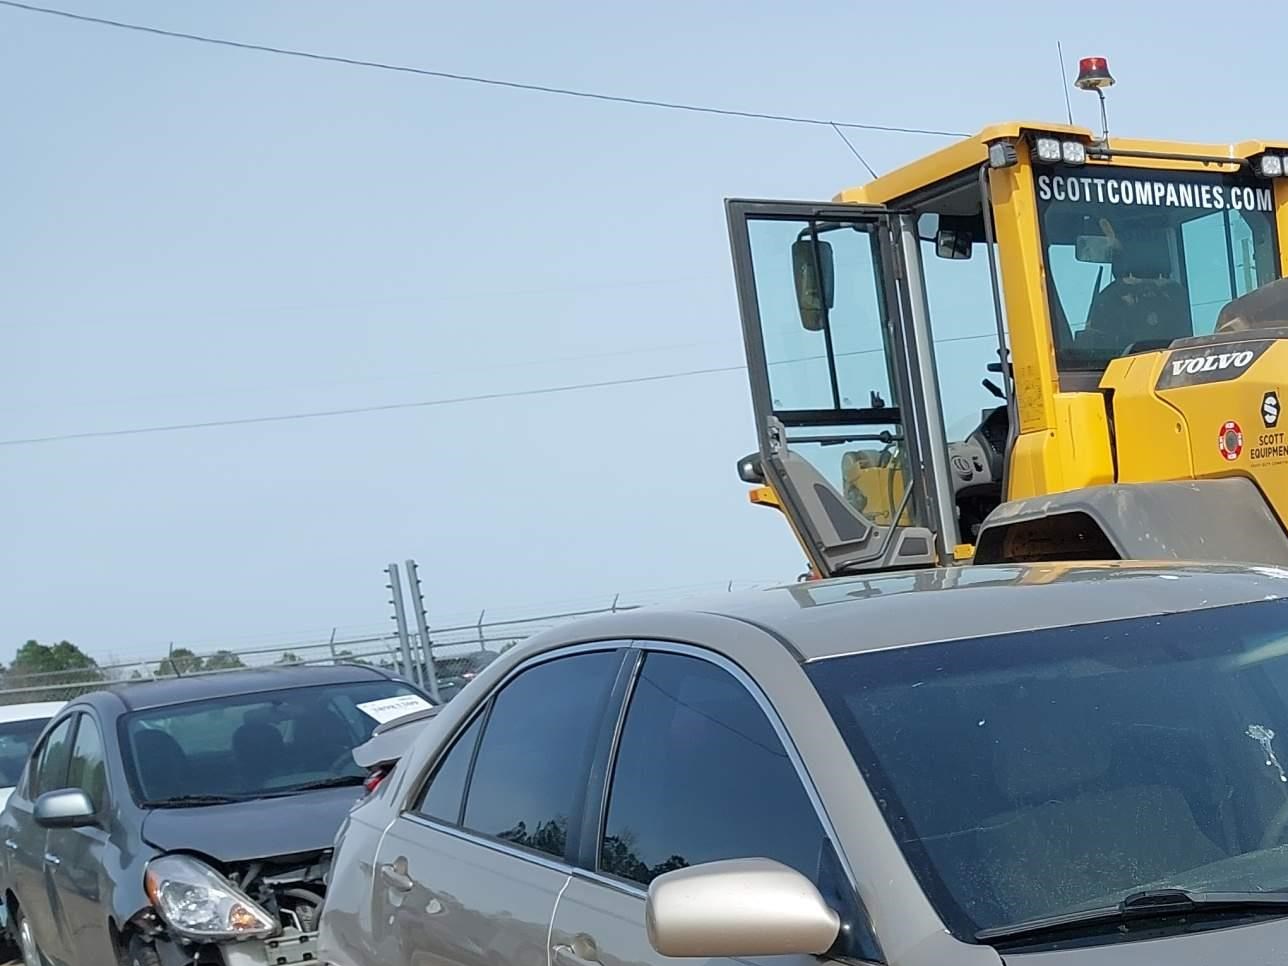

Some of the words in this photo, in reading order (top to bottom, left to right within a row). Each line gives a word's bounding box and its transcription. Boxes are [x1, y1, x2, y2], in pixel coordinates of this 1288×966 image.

[1038, 175, 1273, 212] SCOTTCOMPANIES.COM
[1172, 350, 1254, 376] VOLVO
[1258, 432, 1285, 447] SCOTT
